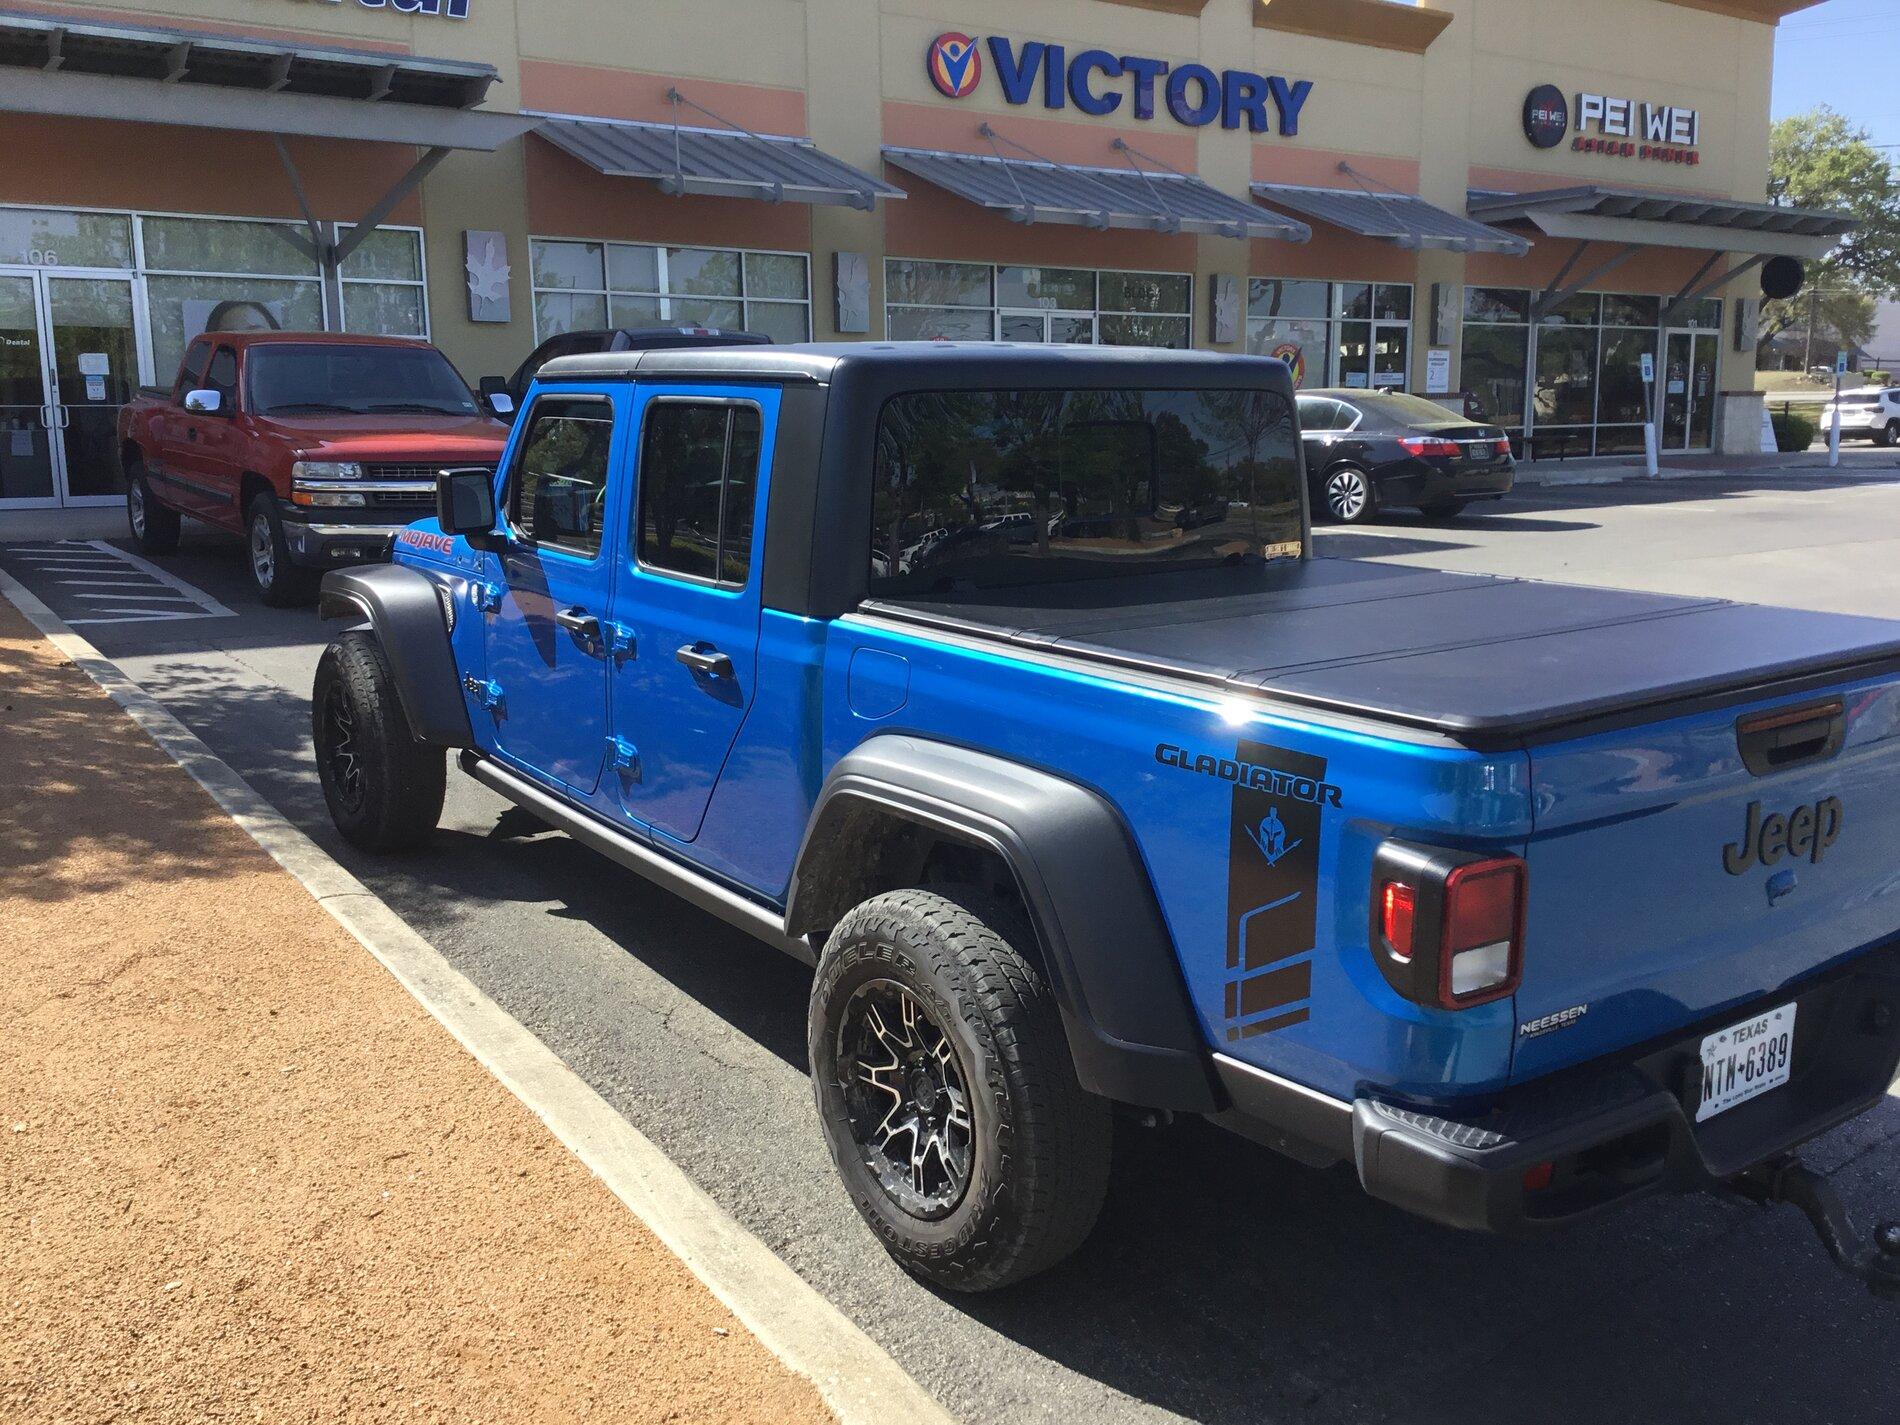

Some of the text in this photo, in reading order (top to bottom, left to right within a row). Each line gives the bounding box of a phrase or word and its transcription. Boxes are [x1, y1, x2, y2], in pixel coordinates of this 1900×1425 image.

[986, 36, 1314, 137] VICTORY
[1575, 93, 1700, 146] PEI WEI
[21, 249, 58, 266] 106
[400, 528, 455, 555] MOJAVE
[1155, 743, 1343, 809] GLADIATOR
[1723, 796, 1841, 876] Jeep
[1520, 1003, 1588, 1035] NEESSEN
[1732, 1018, 1768, 1045] TEXAS
